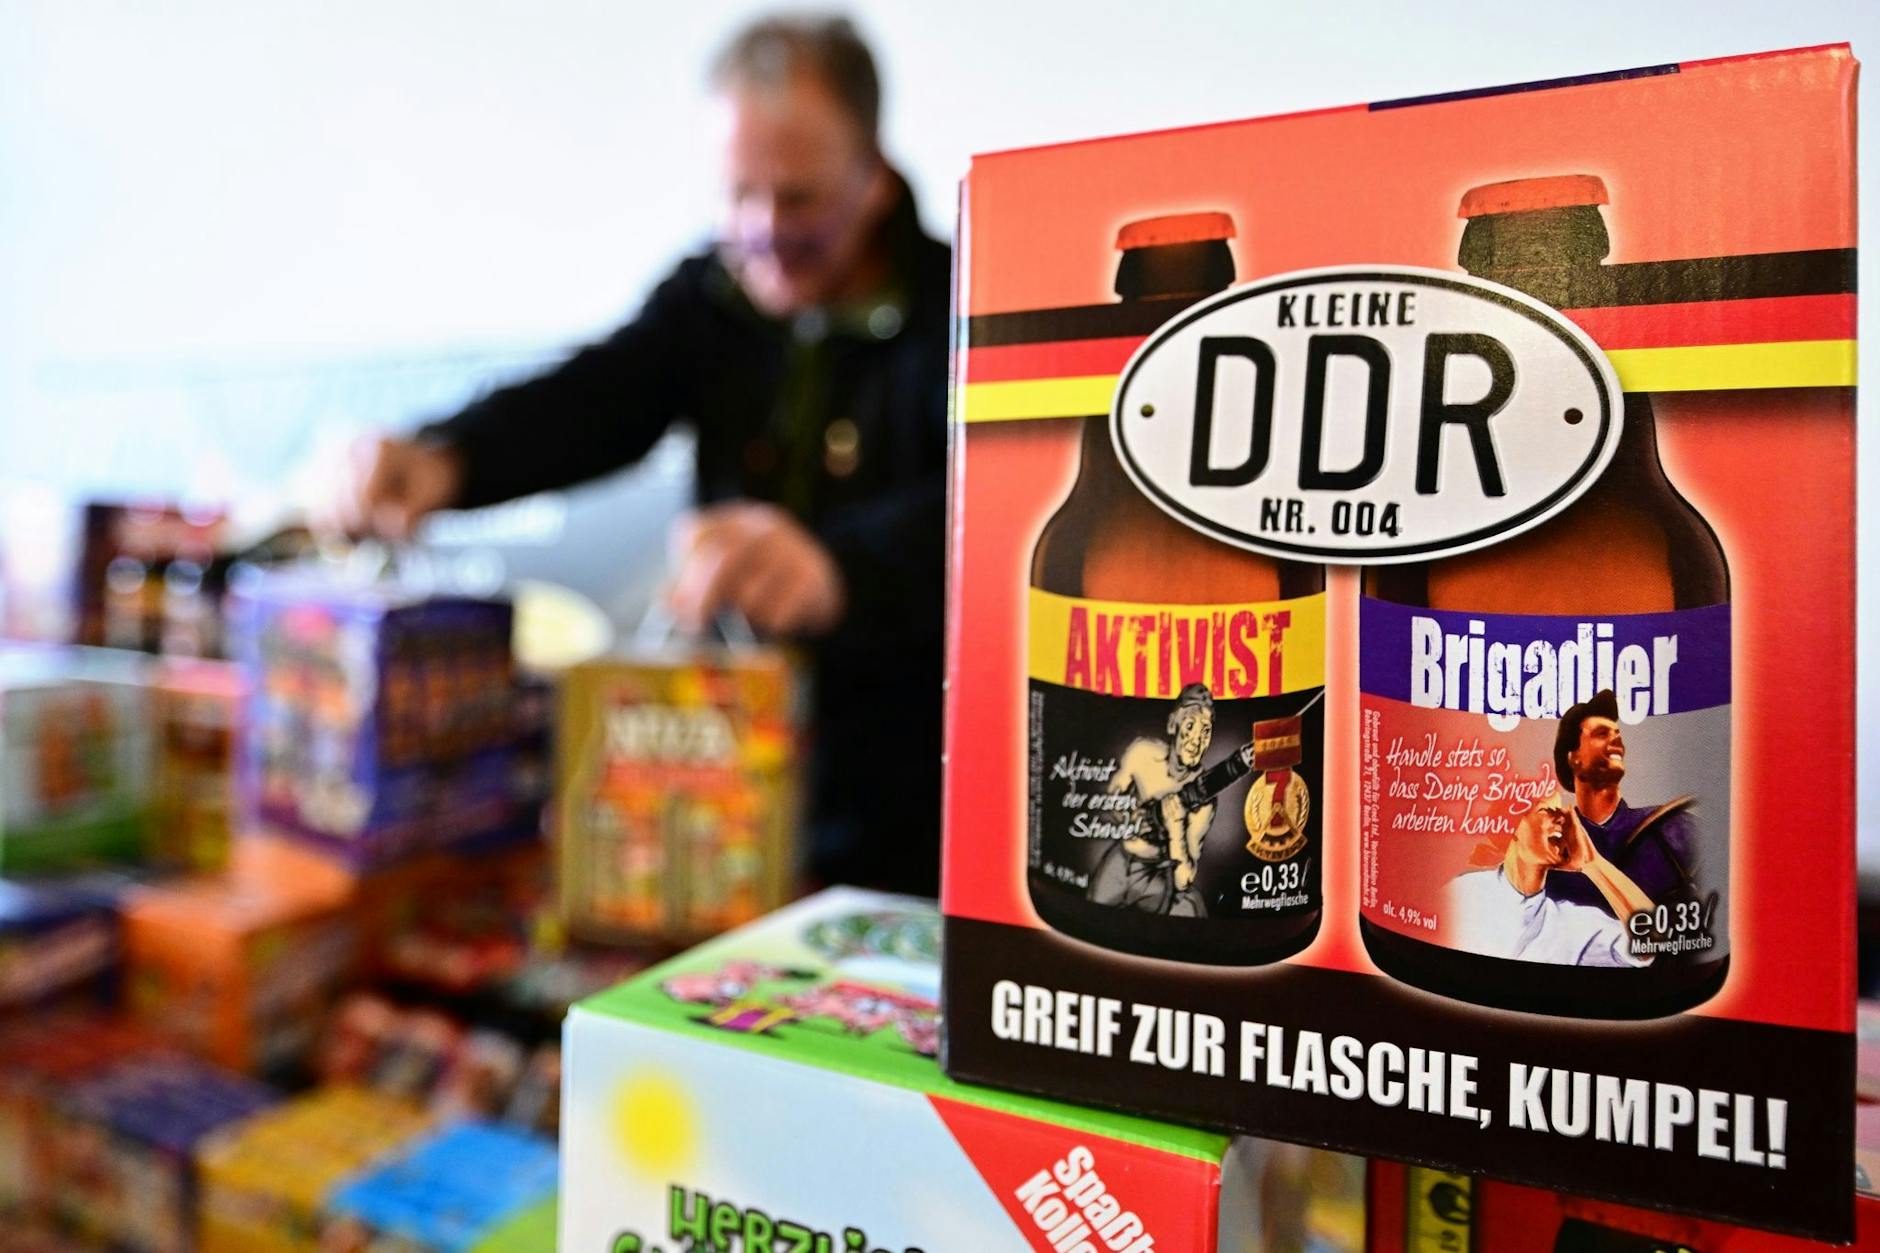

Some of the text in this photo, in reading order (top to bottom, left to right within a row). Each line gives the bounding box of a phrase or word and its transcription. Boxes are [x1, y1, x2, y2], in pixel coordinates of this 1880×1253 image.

[1277, 291, 1418, 328] KLEINE
[1189, 332, 1516, 498] DDR
[1259, 498, 1402, 536] NR. 004
[1065, 606, 1291, 699] AKTIVIST
[1410, 616, 1678, 732] Brigadier
[1386, 733, 1511, 772] Handle stets so,
[1389, 763, 1557, 815] dass Deine Brigade
[1392, 799, 1516, 834] arbeiten kann.
[1383, 900, 1438, 931] alc. 4,9% vol
[1631, 932, 1713, 956] Mehrwegflasche
[990, 980, 1788, 1170] GREIF ZUR FLASCHE, KUMPEL!
